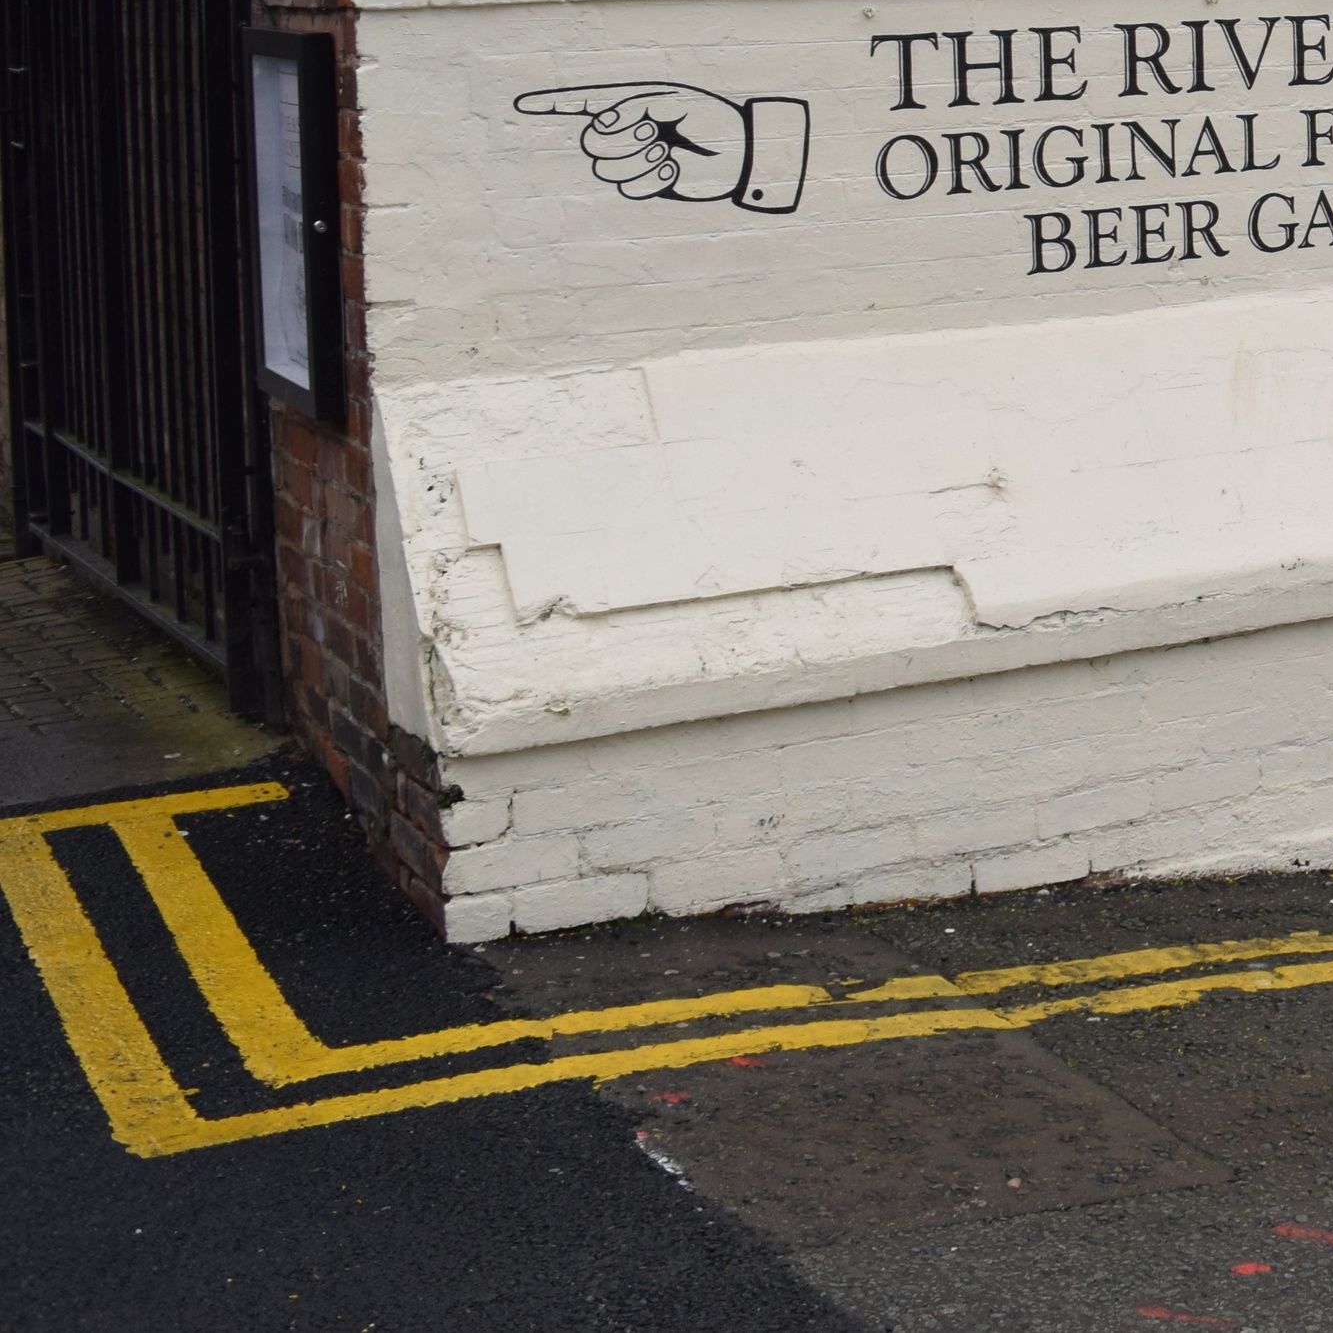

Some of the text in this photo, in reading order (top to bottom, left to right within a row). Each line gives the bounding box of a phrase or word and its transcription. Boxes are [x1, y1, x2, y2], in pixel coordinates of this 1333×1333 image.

[870, 25, 1088, 112] THE
[875, 113, 1281, 201] ORIGINAL
[1023, 200, 1230, 276] BEER
